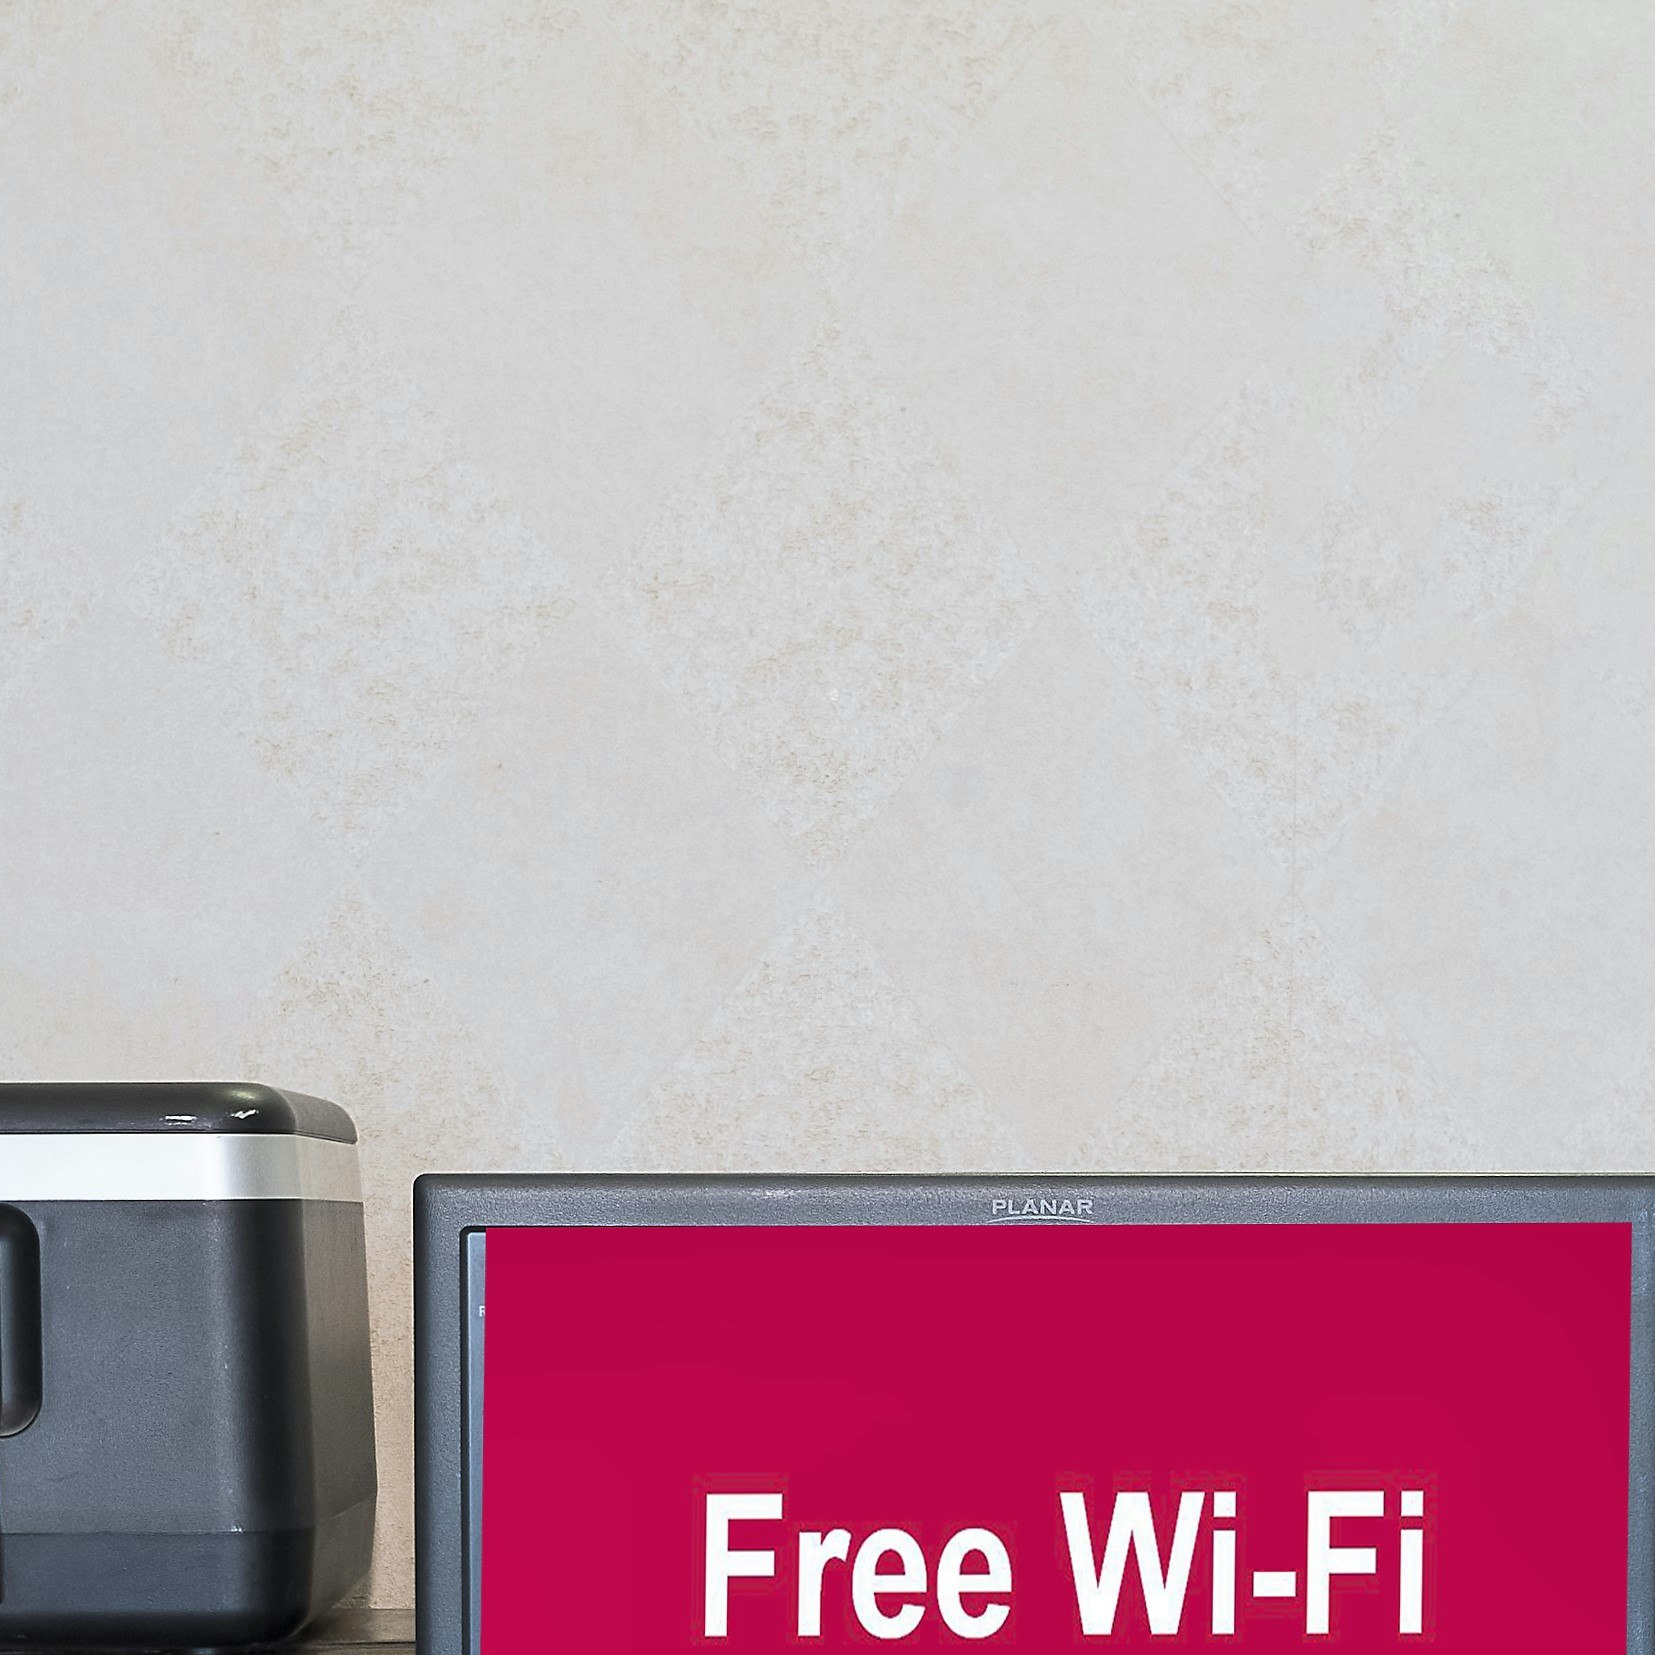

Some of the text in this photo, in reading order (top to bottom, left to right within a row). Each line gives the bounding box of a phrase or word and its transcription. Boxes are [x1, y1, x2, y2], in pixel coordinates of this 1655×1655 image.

[993, 1199, 1093, 1215] PLANAR
[704, 1490, 1424, 1640] Free Wi-Fi
